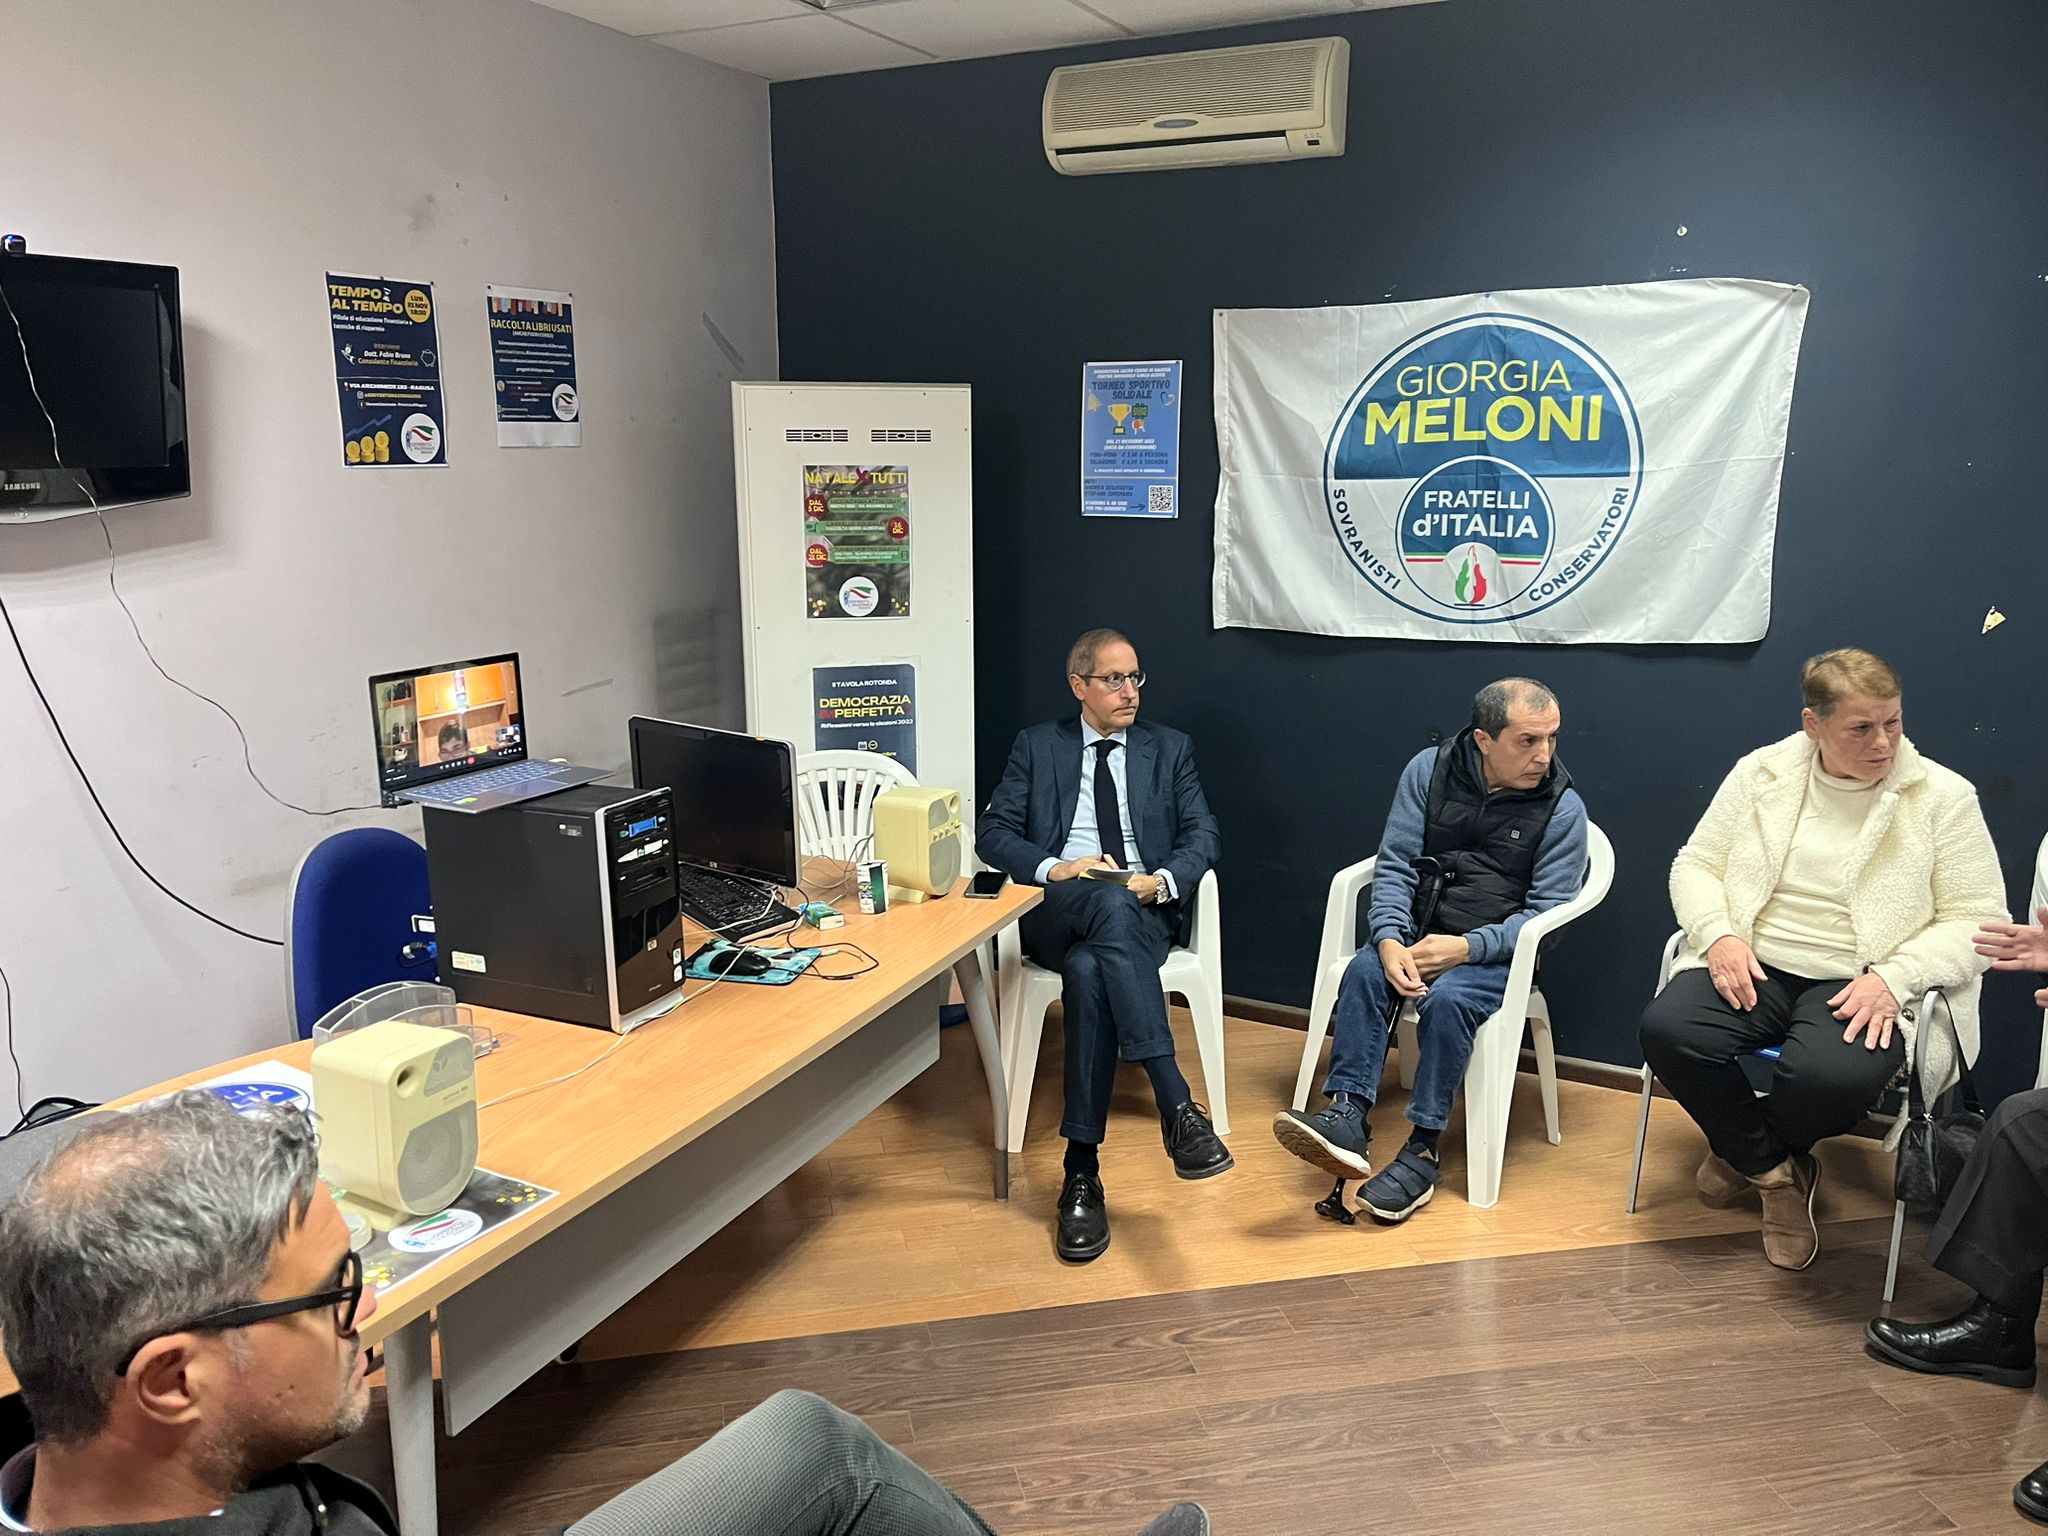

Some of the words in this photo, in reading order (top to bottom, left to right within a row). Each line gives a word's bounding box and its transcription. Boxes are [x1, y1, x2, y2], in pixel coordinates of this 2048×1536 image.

[329, 285, 382, 299] TEMPO
[332, 298, 350, 310] AL
[352, 300, 404, 314] TEMPO
[491, 319, 532, 331] RACCOLTA
[532, 322, 551, 332] LIBRI
[552, 324, 572, 334] USATI
[1092, 381, 1125, 390] TORNEO
[1128, 379, 1171, 389] SPORTIVO
[1396, 359, 1572, 396] GIORGIA
[1112, 390, 1153, 400] SOLIDALE
[1363, 394, 1603, 445] MELONI
[4, 482, 41, 490] SAMSUNG
[805, 472, 856, 485] NATALE
[870, 472, 907, 484] TUTTI
[1423, 489, 1530, 512] FRATELLI
[1412, 512, 1539, 540] d'ITALIA
[1333, 487, 1401, 590] SOVRANISTI
[1528, 486, 1630, 602] CONSERVATORI
[820, 694, 911, 708] DEMOCRAZIA
